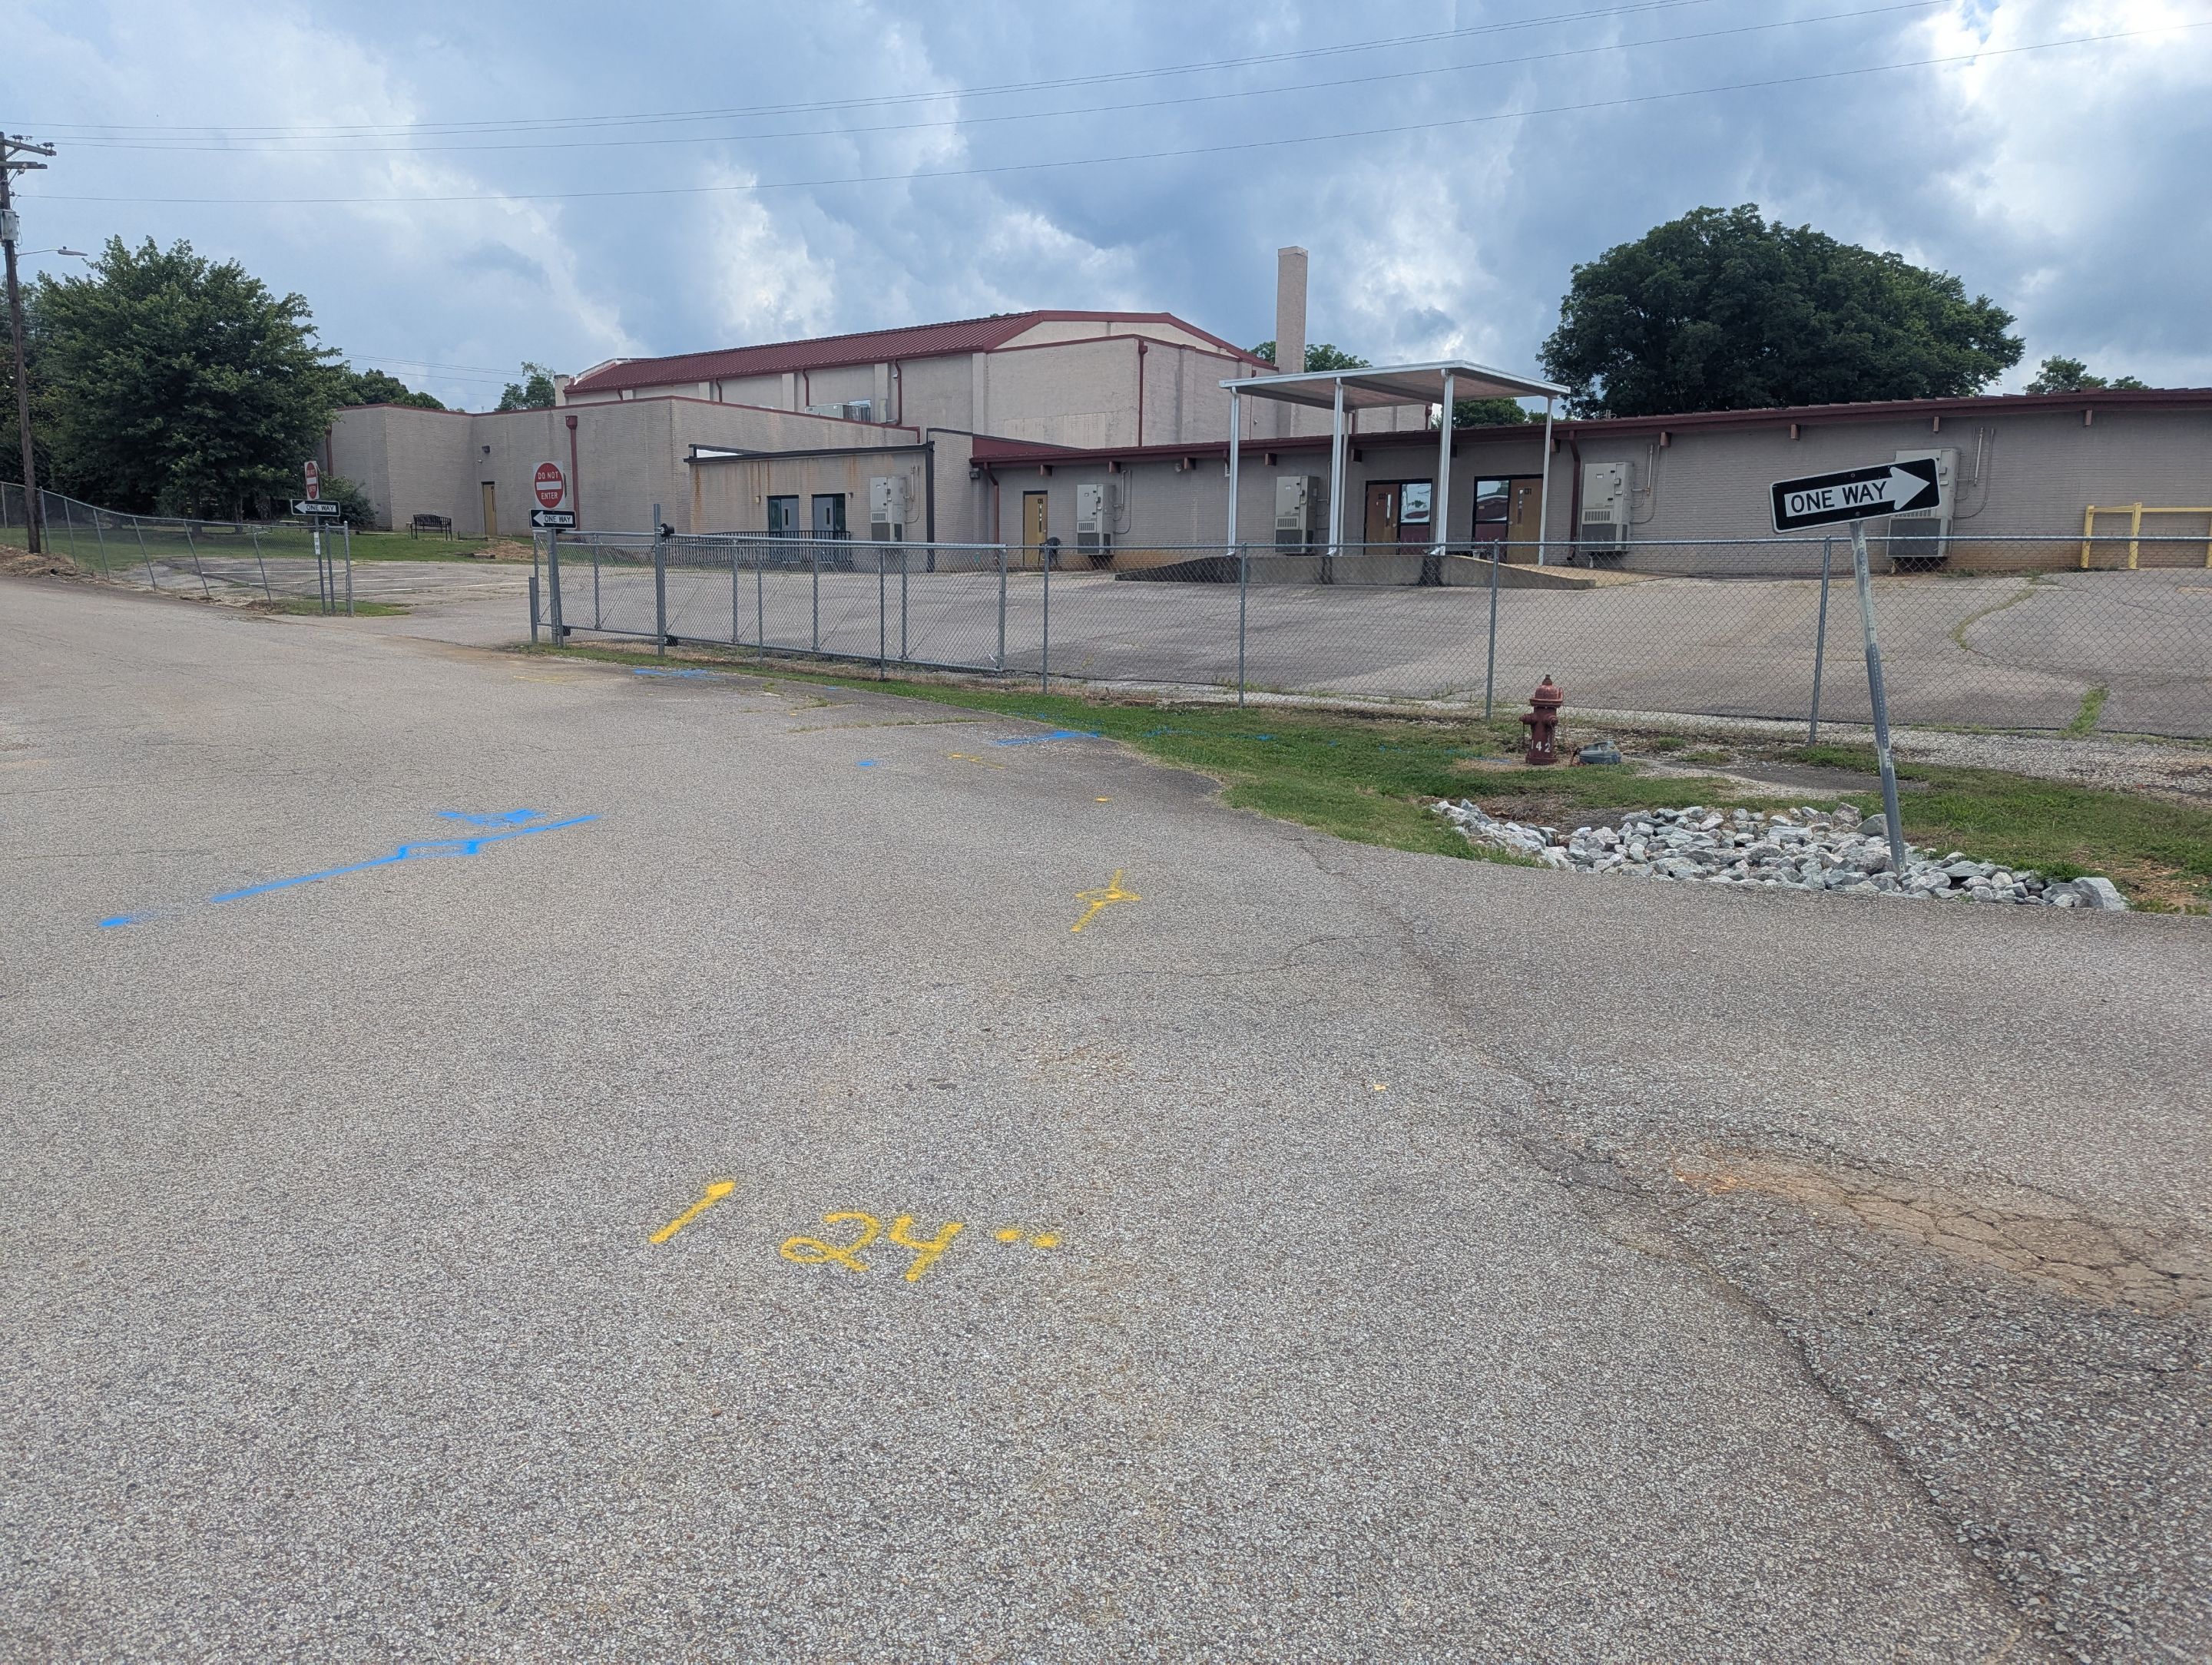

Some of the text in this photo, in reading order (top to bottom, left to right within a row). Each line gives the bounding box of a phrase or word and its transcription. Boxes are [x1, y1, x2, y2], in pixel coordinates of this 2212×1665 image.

[547, 471, 558, 479] NOT
[1790, 481, 1887, 513] ONE WAY
